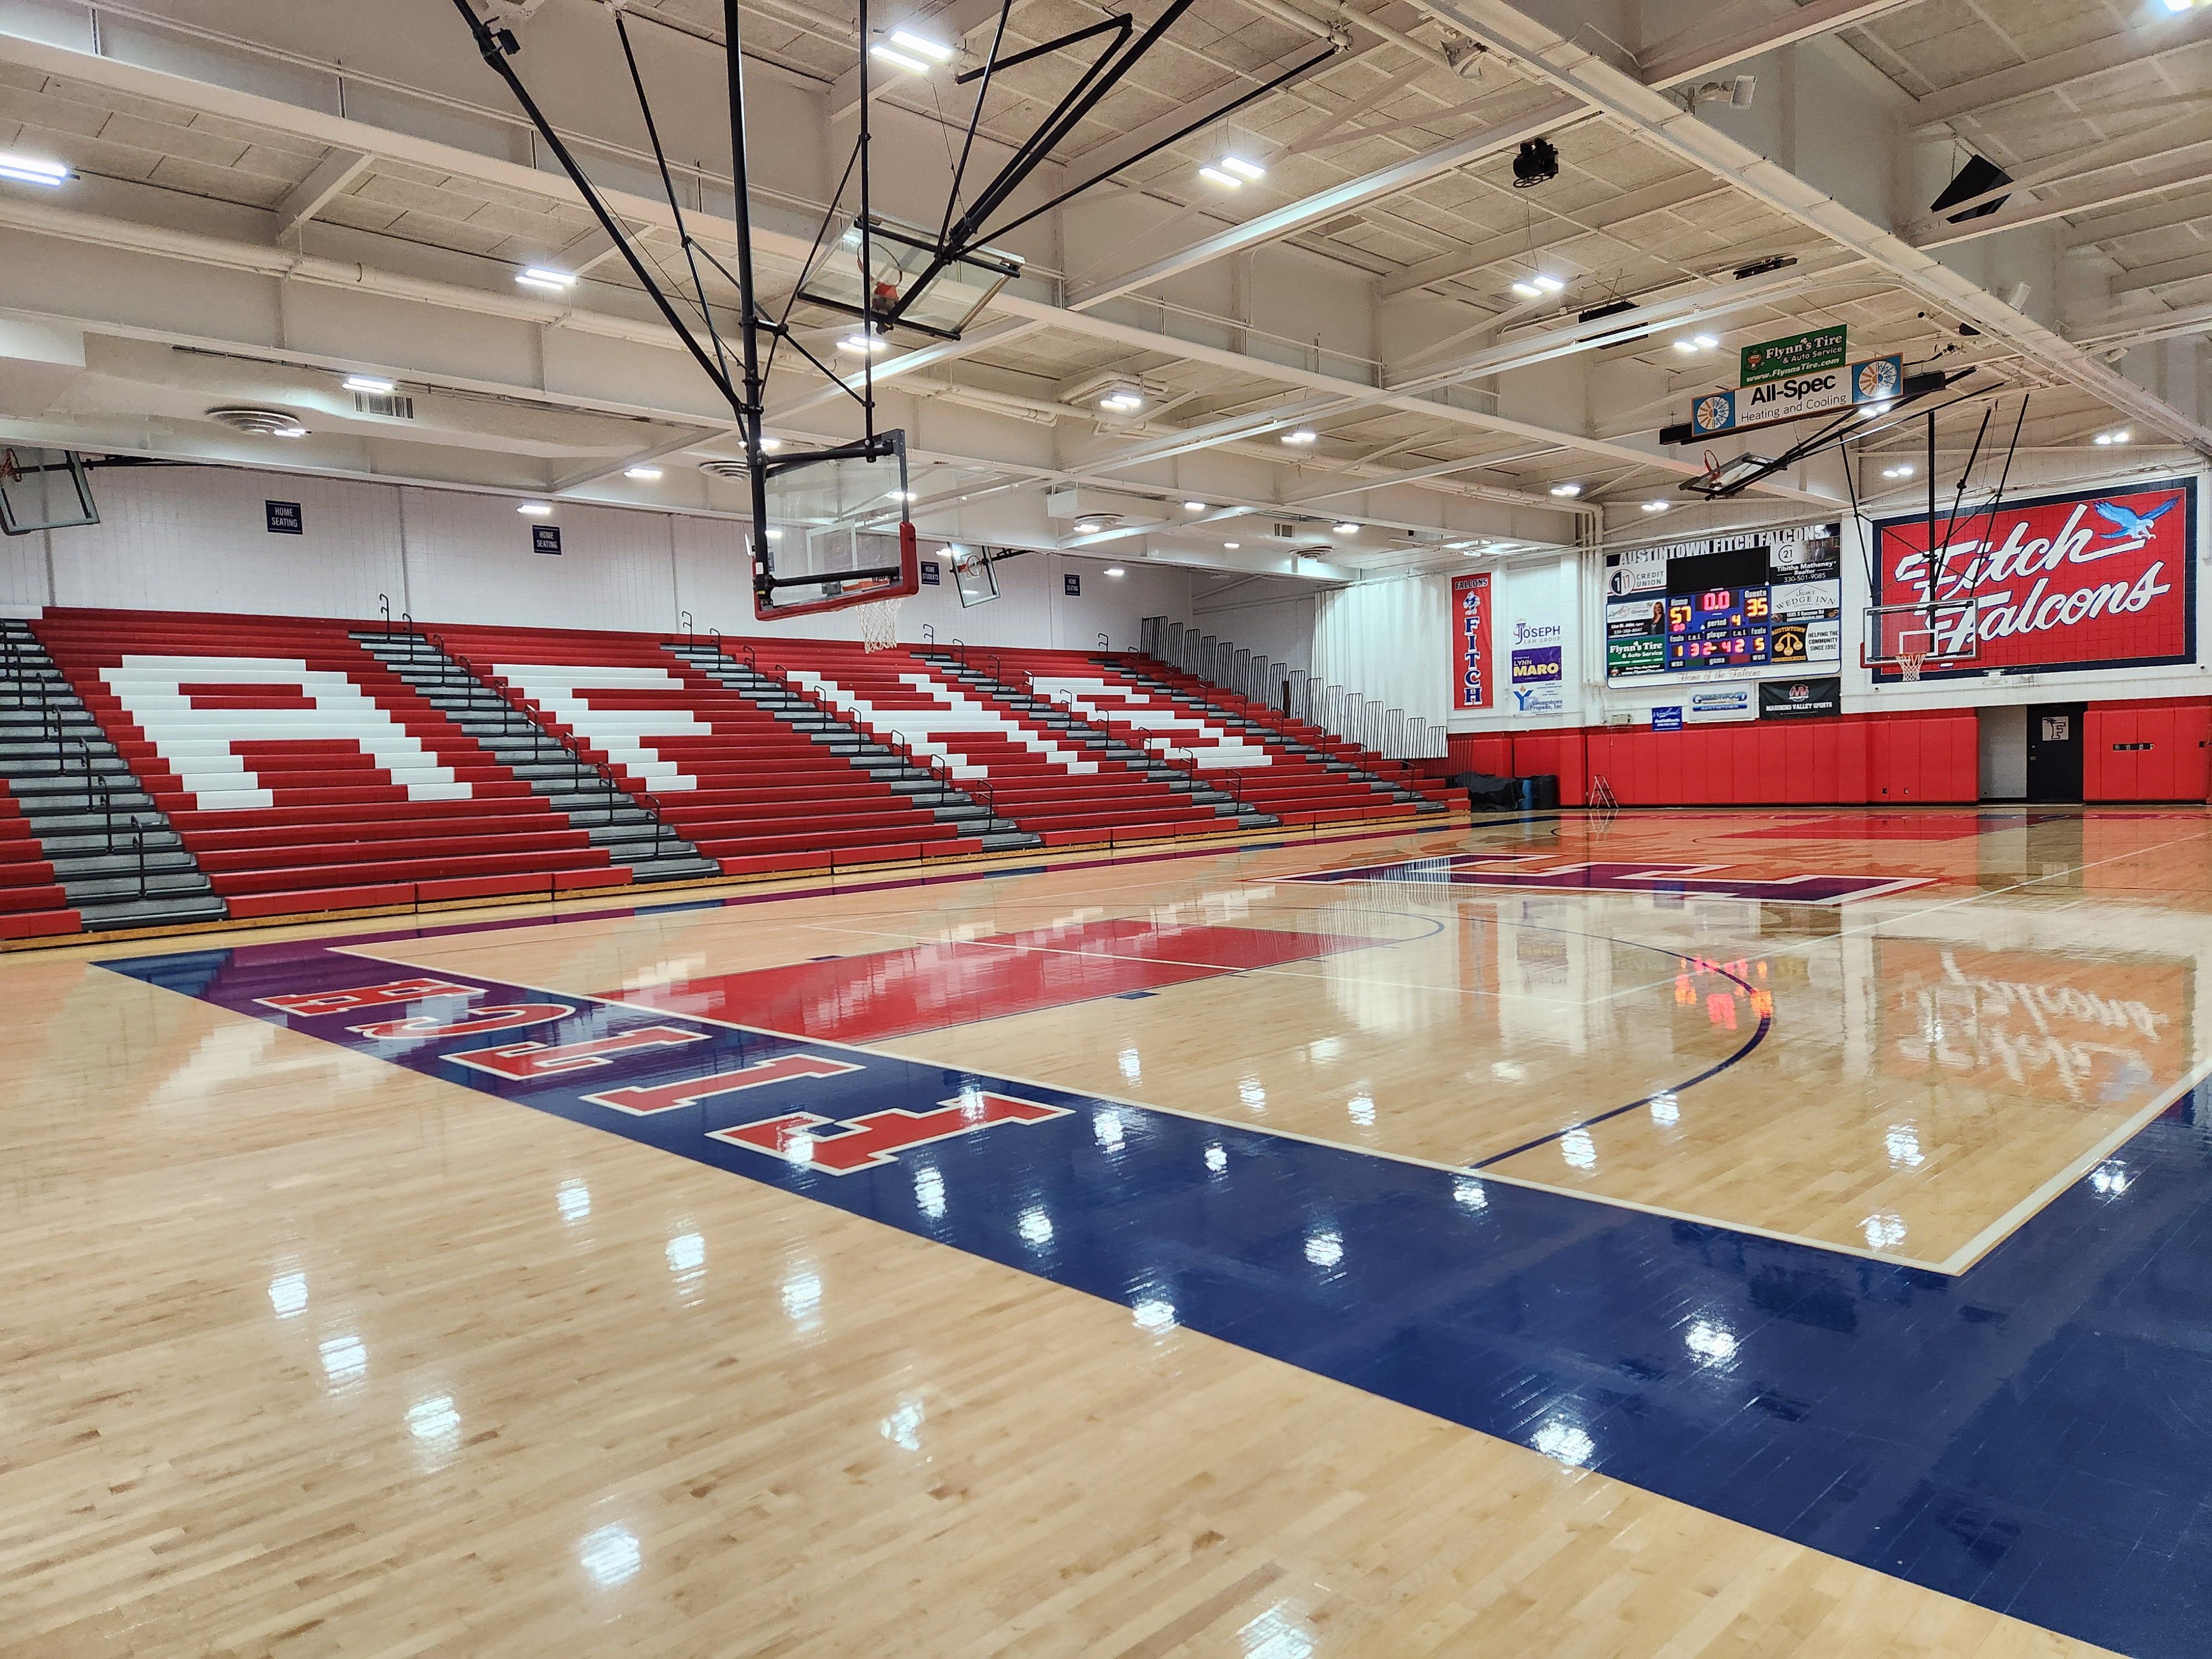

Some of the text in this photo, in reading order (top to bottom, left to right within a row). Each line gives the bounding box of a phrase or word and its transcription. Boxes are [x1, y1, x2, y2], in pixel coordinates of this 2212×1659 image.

[1766, 335, 1843, 359] Flynn's Tire
[1783, 347, 1843, 364] & Auto Service
[1746, 358, 1840, 382] www.FlynnsTire.com
[1750, 374, 1837, 406] All-Spec
[1741, 394, 1846, 423] Heating and Cooling
[275, 507, 294, 517] HOME
[272, 517, 298, 527] SEATING
[539, 530, 554, 539] HOME
[536, 539, 558, 549] SEATING
[1619, 524, 1825, 566] AUSTINTOWN FITCH FALCONS
[1895, 504, 2146, 616] Fitch
[1636, 571, 1664, 580] CREDIT
[1636, 578, 1662, 587] UNION
[1783, 572, 1826, 582] 330-501-9085
[1455, 577, 1488, 590] FALCONS
[1704, 591, 1730, 611] 0.0
[1744, 589, 1767, 598] Guests
[1746, 597, 1768, 617] 35
[1776, 596, 1812, 610] WEDGE
[1816, 596, 1836, 606] INN
[1670, 606, 1692, 624] 57
[1731, 614, 1741, 626] 4
[1924, 560, 2171, 667] Falcons
[1515, 624, 1561, 644] JOSEPH
[1609, 641, 1663, 655] Flynn's Tire
[1677, 645, 1683, 657] 1
[1464, 616, 1483, 706] FITCH
[1514, 662, 1559, 677] MARO
[1704, 670, 1712, 682] of
[1715, 670, 1725, 679] the
[1729, 669, 1761, 679] Falcons
[2051, 721, 2066, 739] F
